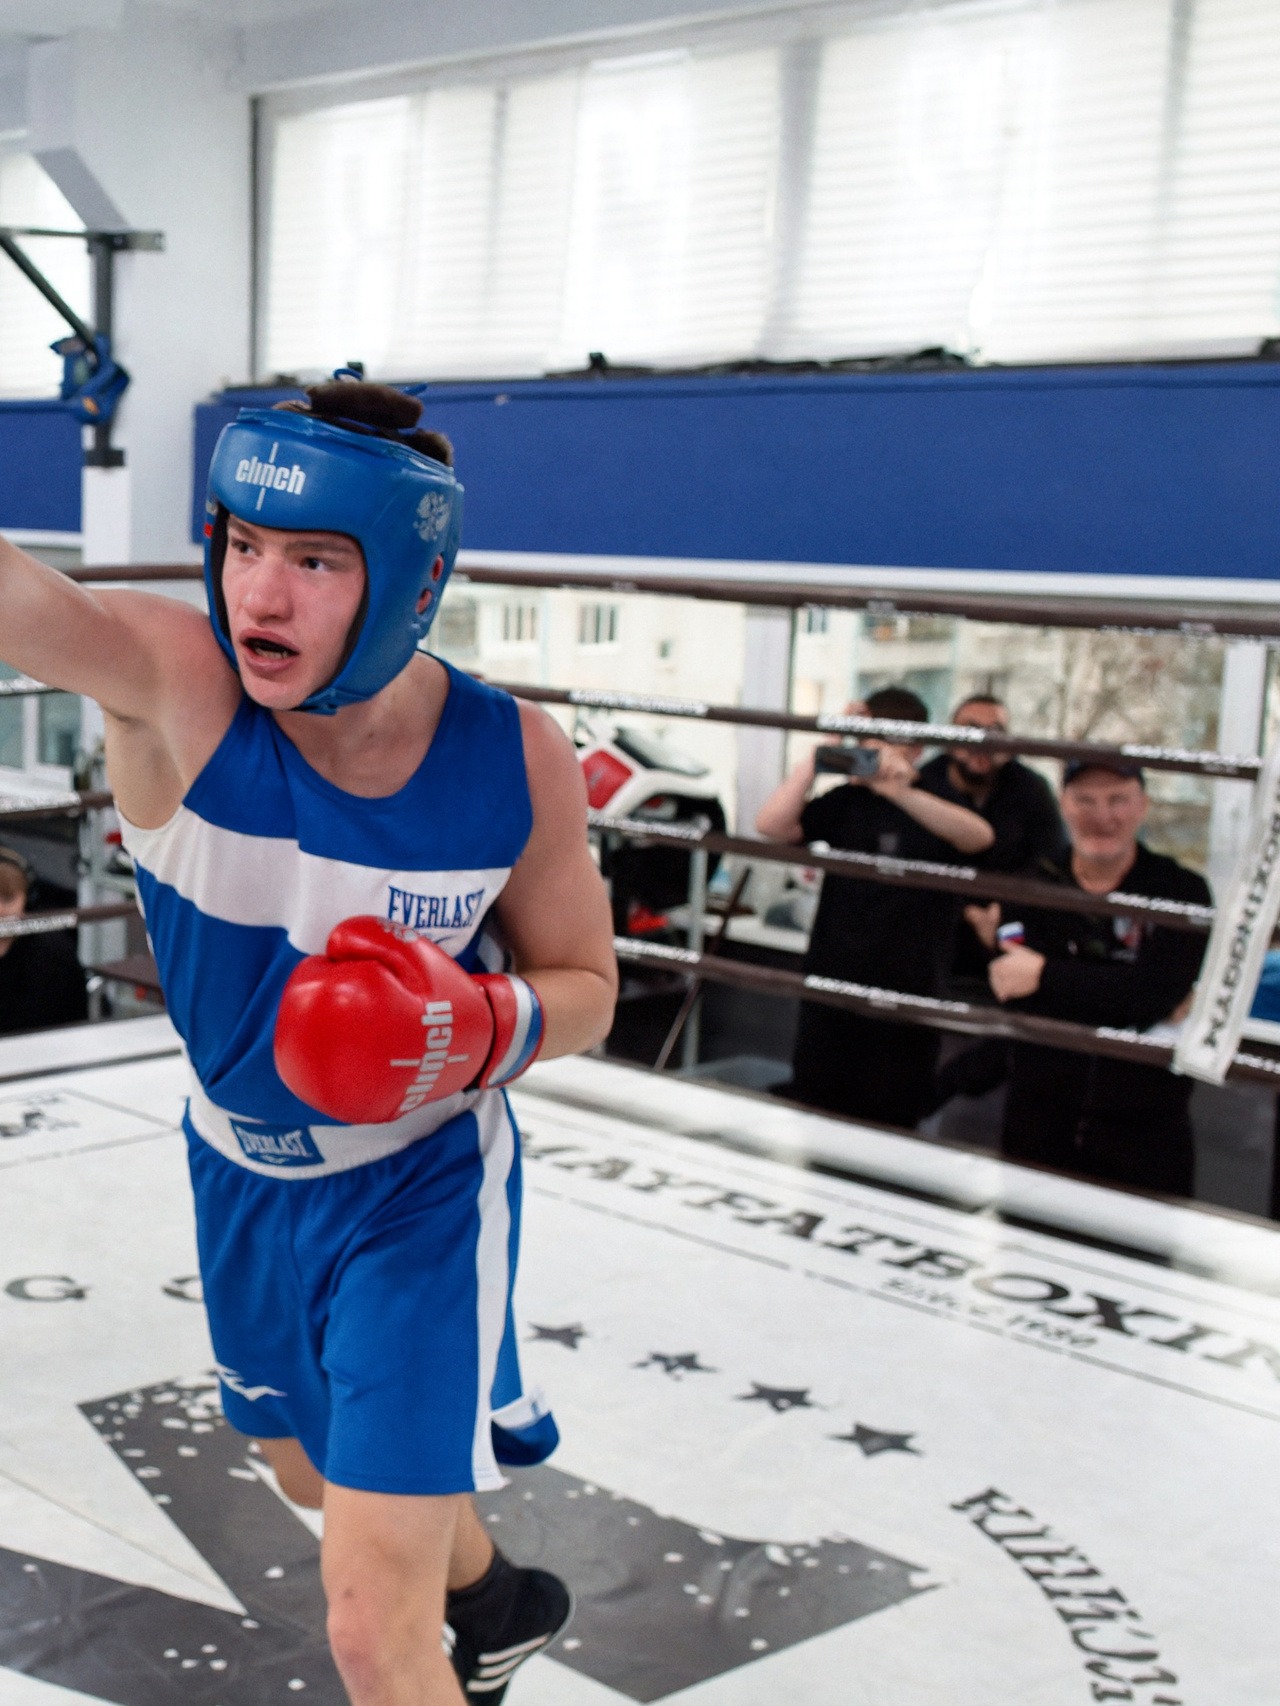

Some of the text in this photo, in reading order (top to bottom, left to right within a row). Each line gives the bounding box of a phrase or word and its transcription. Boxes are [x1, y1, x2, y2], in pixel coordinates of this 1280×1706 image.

[235, 456, 307, 495] clinch
[388, 885, 484, 929] EVERLAST
[400, 1000, 453, 1111] clinch
[234, 1125, 313, 1158] EVERLAST
